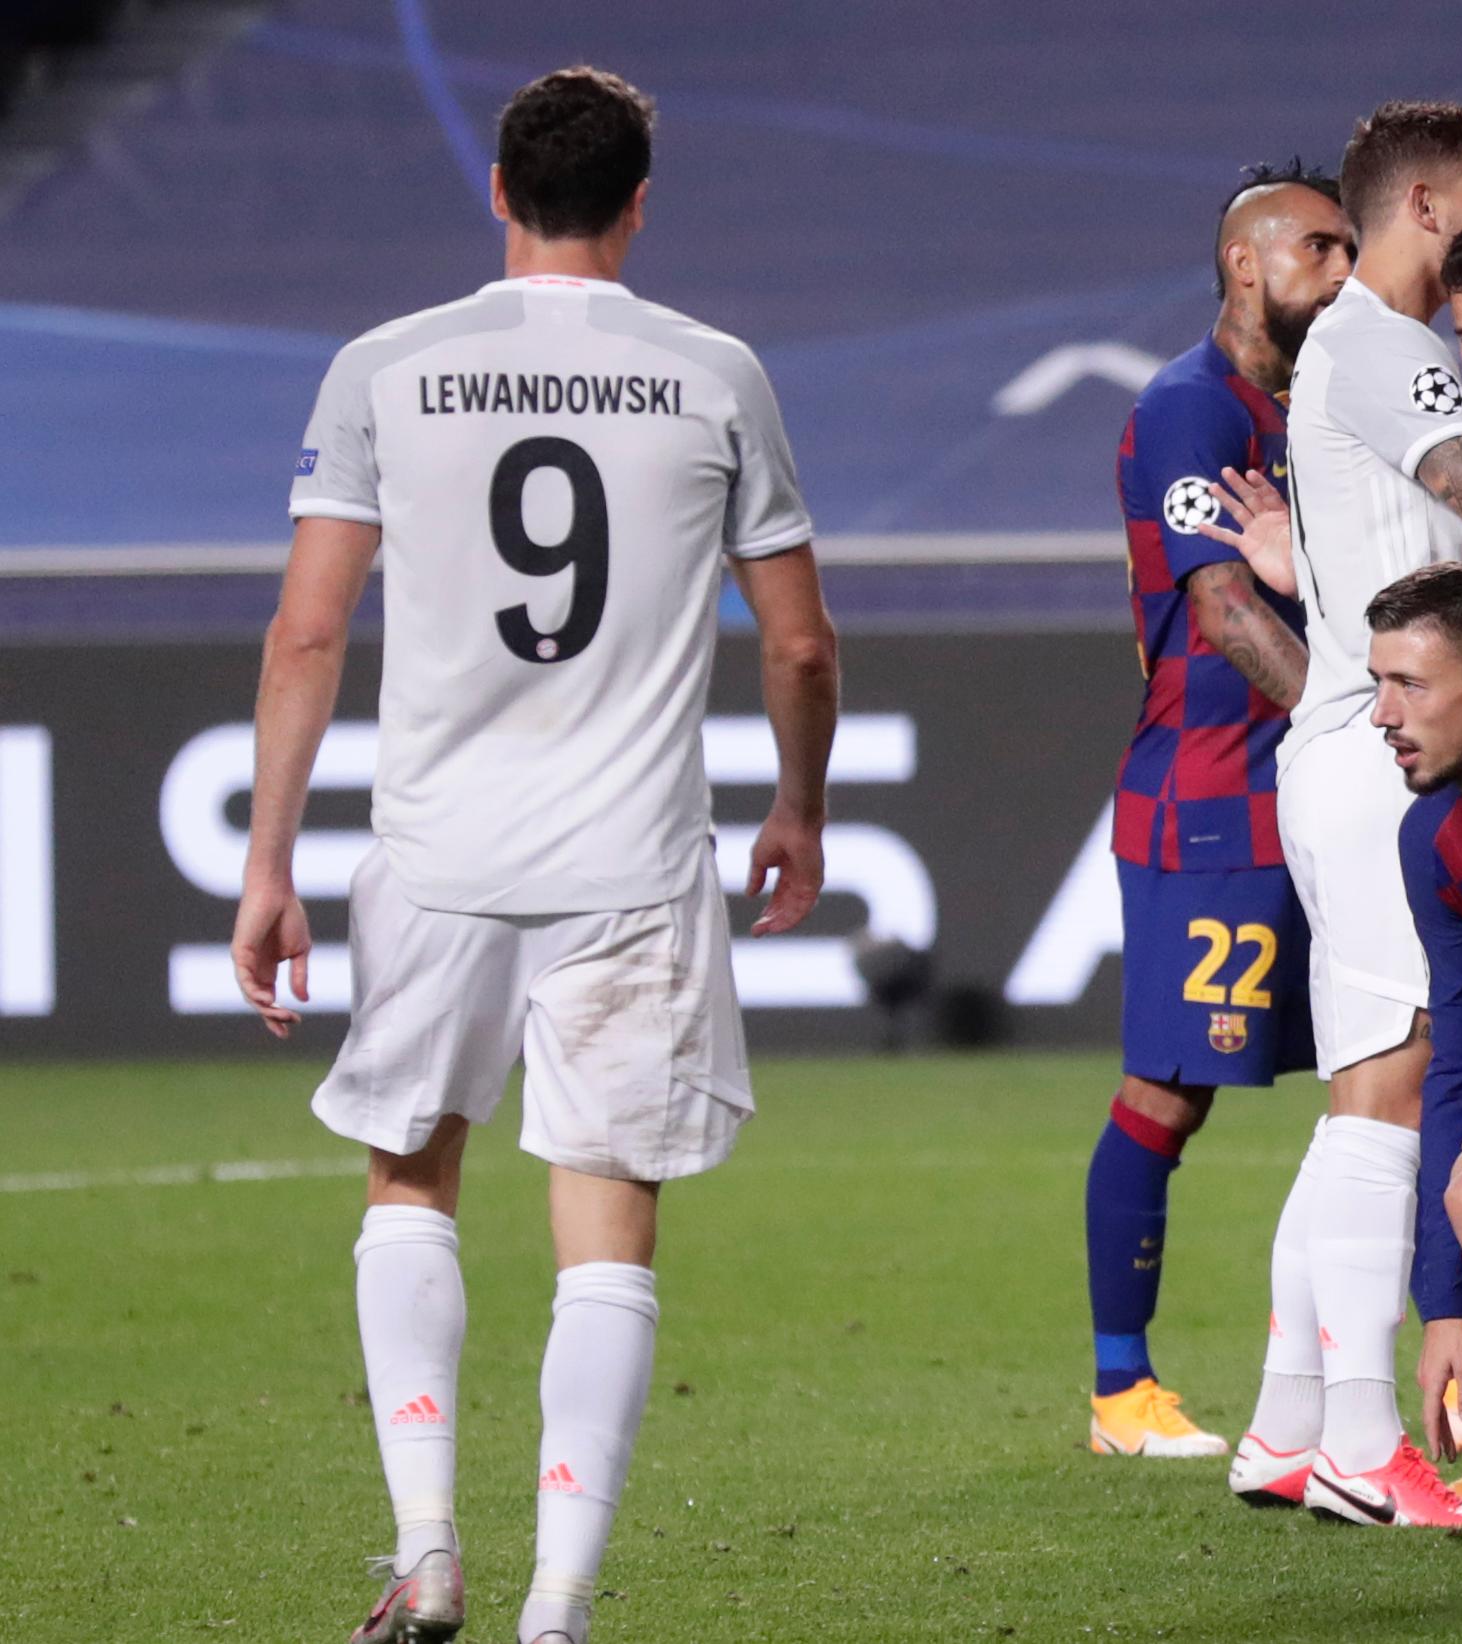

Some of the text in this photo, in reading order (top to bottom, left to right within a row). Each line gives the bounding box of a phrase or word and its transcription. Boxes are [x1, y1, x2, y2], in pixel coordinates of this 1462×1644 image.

[420, 372, 681, 415] LEWANDOWSKI
[488, 436, 609, 664] 9
[1183, 918, 1277, 1008] 22
